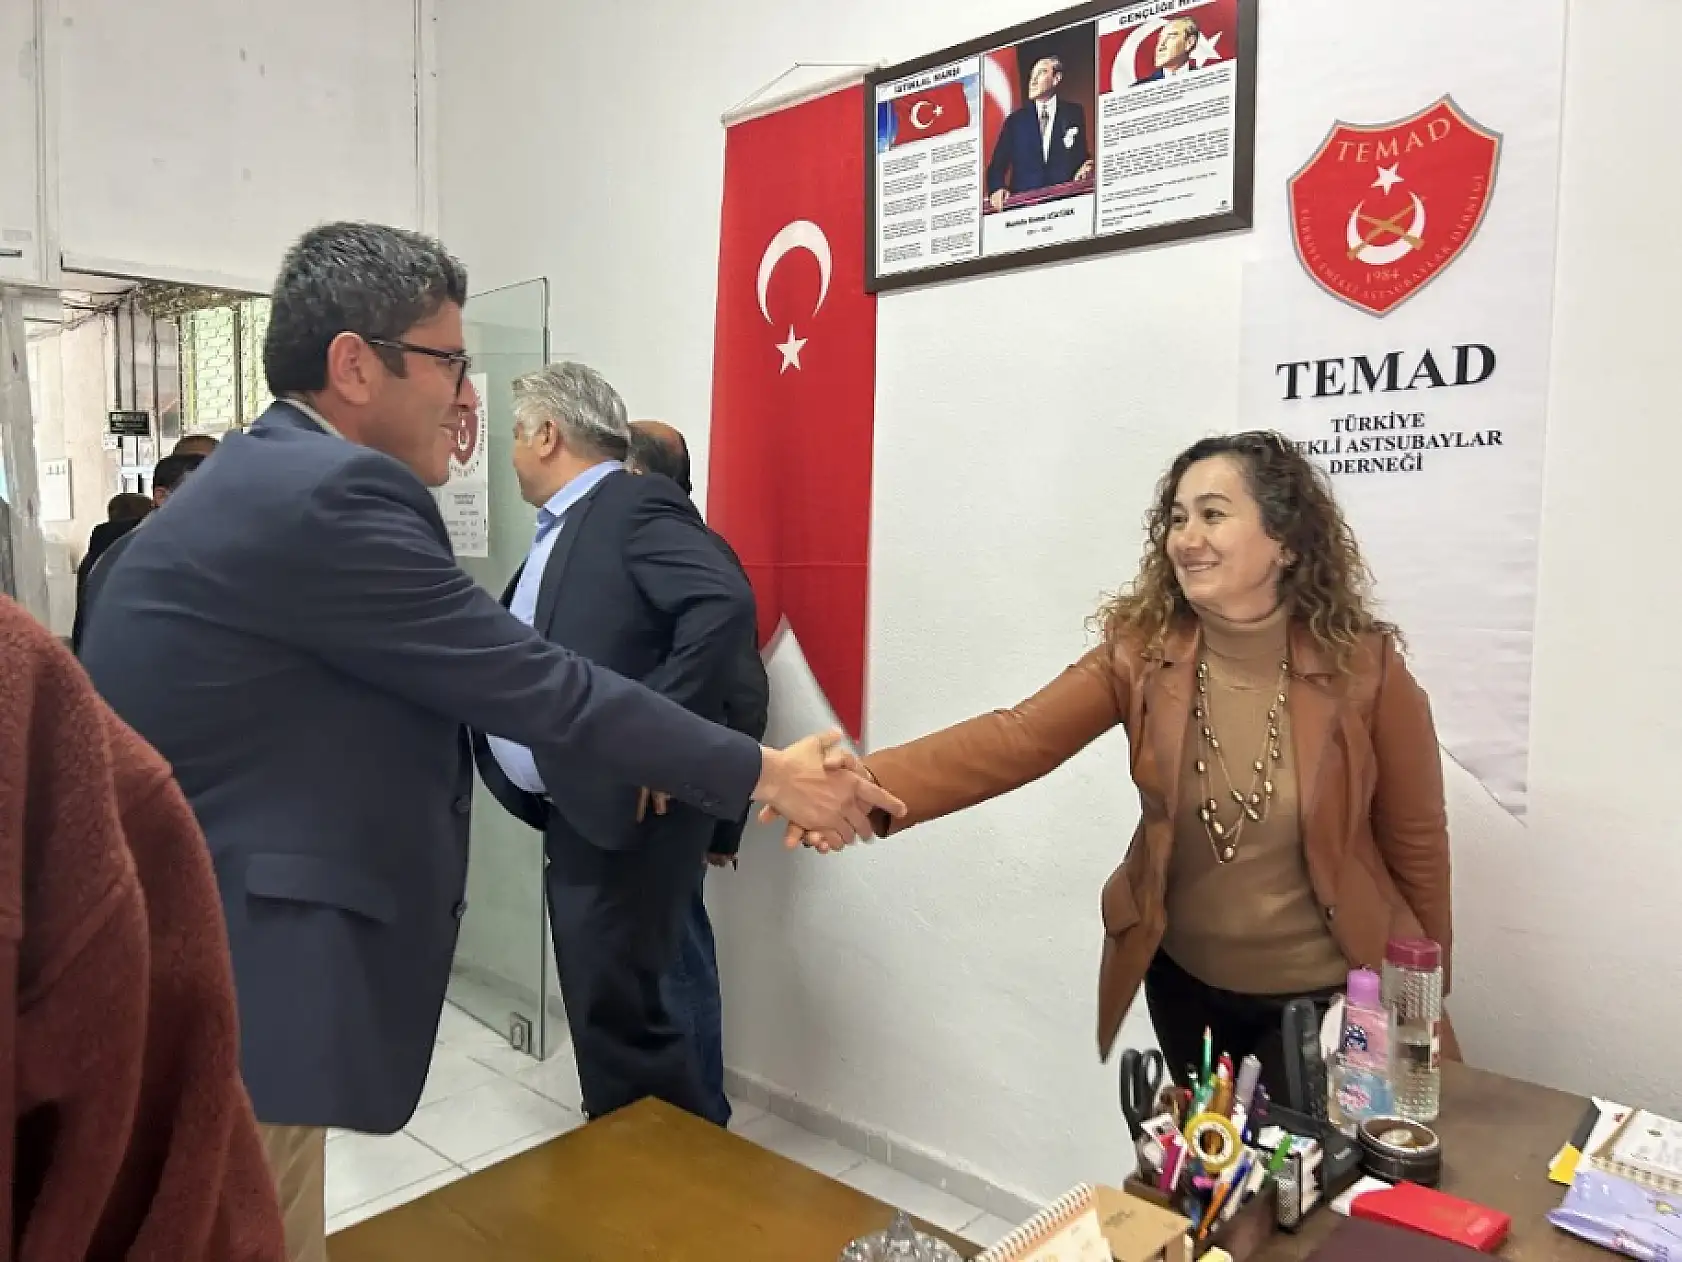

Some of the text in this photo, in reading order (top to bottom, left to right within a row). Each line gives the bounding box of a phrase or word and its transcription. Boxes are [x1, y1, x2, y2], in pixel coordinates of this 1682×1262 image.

[1335, 118, 1451, 163] TEMAD
[1275, 343, 1497, 400] TEMAD
[1330, 410, 1426, 433] TÜRKİYE
[1293, 429, 1504, 456] EKLİ ASTSUBAYLAR
[1330, 452, 1424, 475] DERNEĞİ
